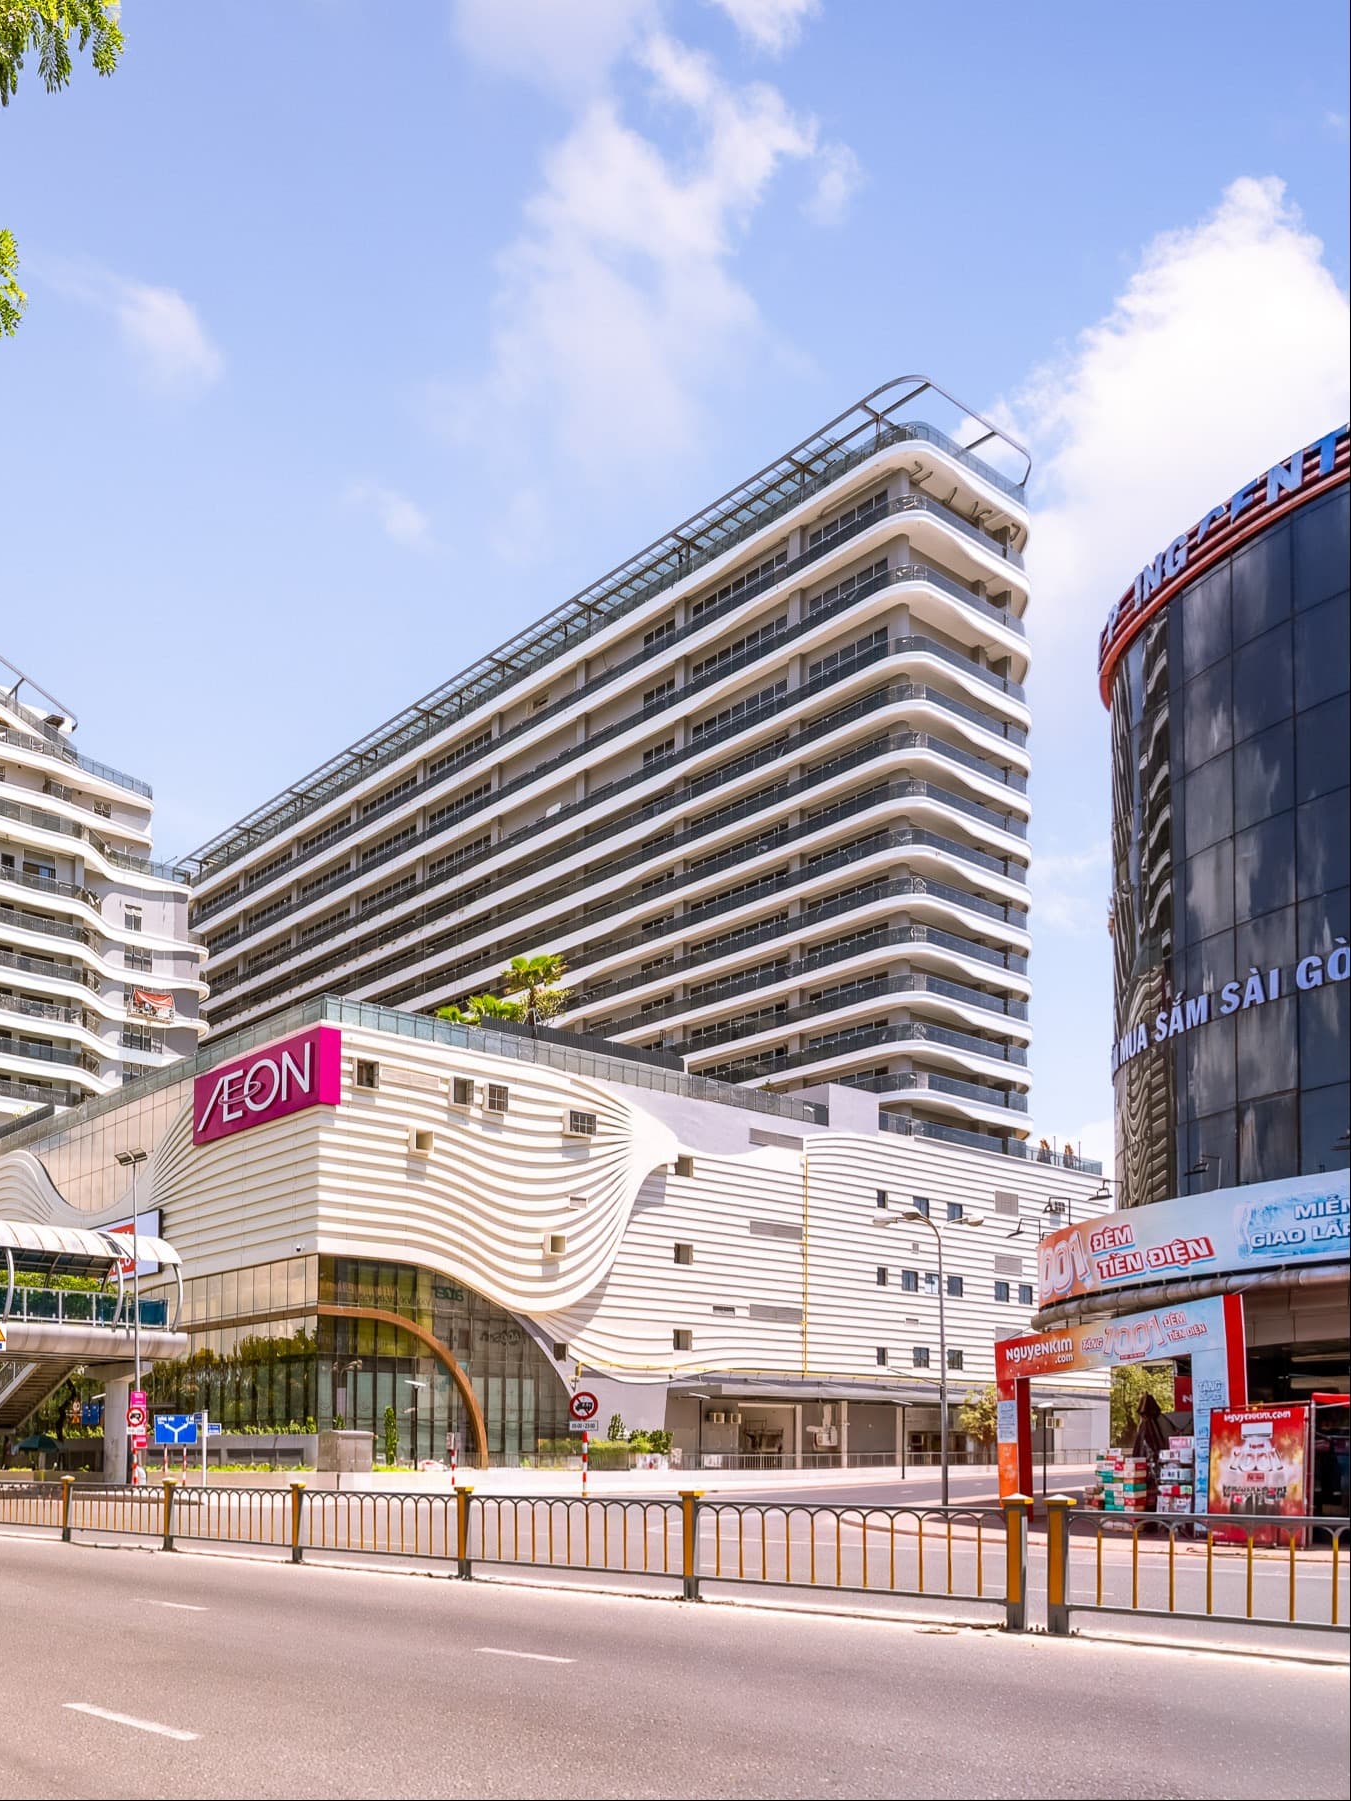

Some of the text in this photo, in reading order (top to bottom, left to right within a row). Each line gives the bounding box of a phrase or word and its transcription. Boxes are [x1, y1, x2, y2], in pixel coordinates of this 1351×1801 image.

[1098, 534, 1188, 672] PING
[1119, 1022, 1148, 1065] MUA
[1155, 991, 1208, 1042] SẮM
[1219, 967, 1280, 1015] SÀI
[1092, 1226, 1133, 1251] ĐÊM
[1249, 1227, 1305, 1248] GIAO
[1098, 1238, 1211, 1278] TIỀN ĐIỆN
[1104, 1315, 1165, 1355] 1001
